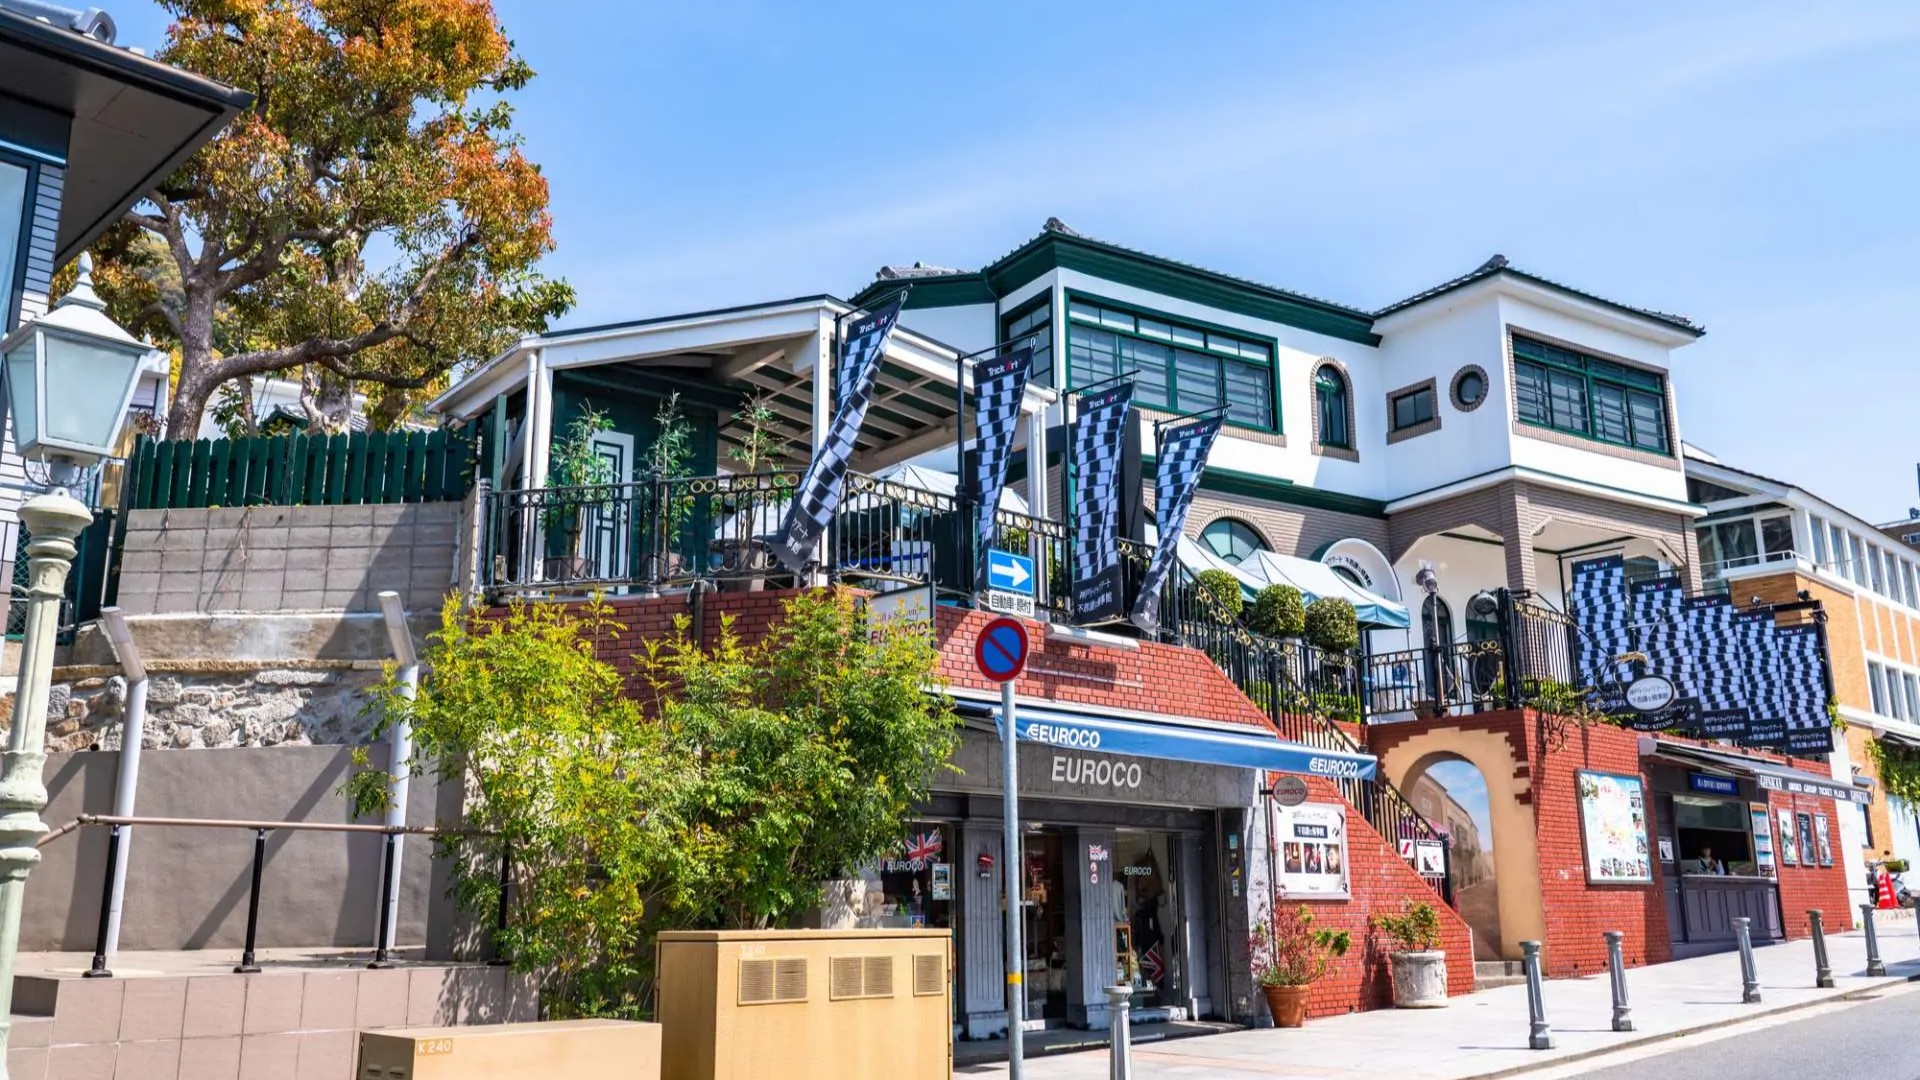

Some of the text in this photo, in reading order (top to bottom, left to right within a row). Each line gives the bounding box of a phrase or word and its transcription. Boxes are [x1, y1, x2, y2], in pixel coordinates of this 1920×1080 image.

[859, 322, 876, 334] Trick
[988, 365, 1005, 376] Trick
[1088, 400, 1105, 409] Trick
[1039, 725, 1100, 748] EUROCO
[1051, 756, 1142, 788] EUROCO
[1317, 759, 1358, 776] EUROCO
[1818, 786, 1833, 797] TICKET
[1833, 789, 1846, 799] PLAZA
[887, 859, 925, 871] EUROCO
[1123, 866, 1152, 876] EUROCO
[418, 1039, 452, 1054] K 240
